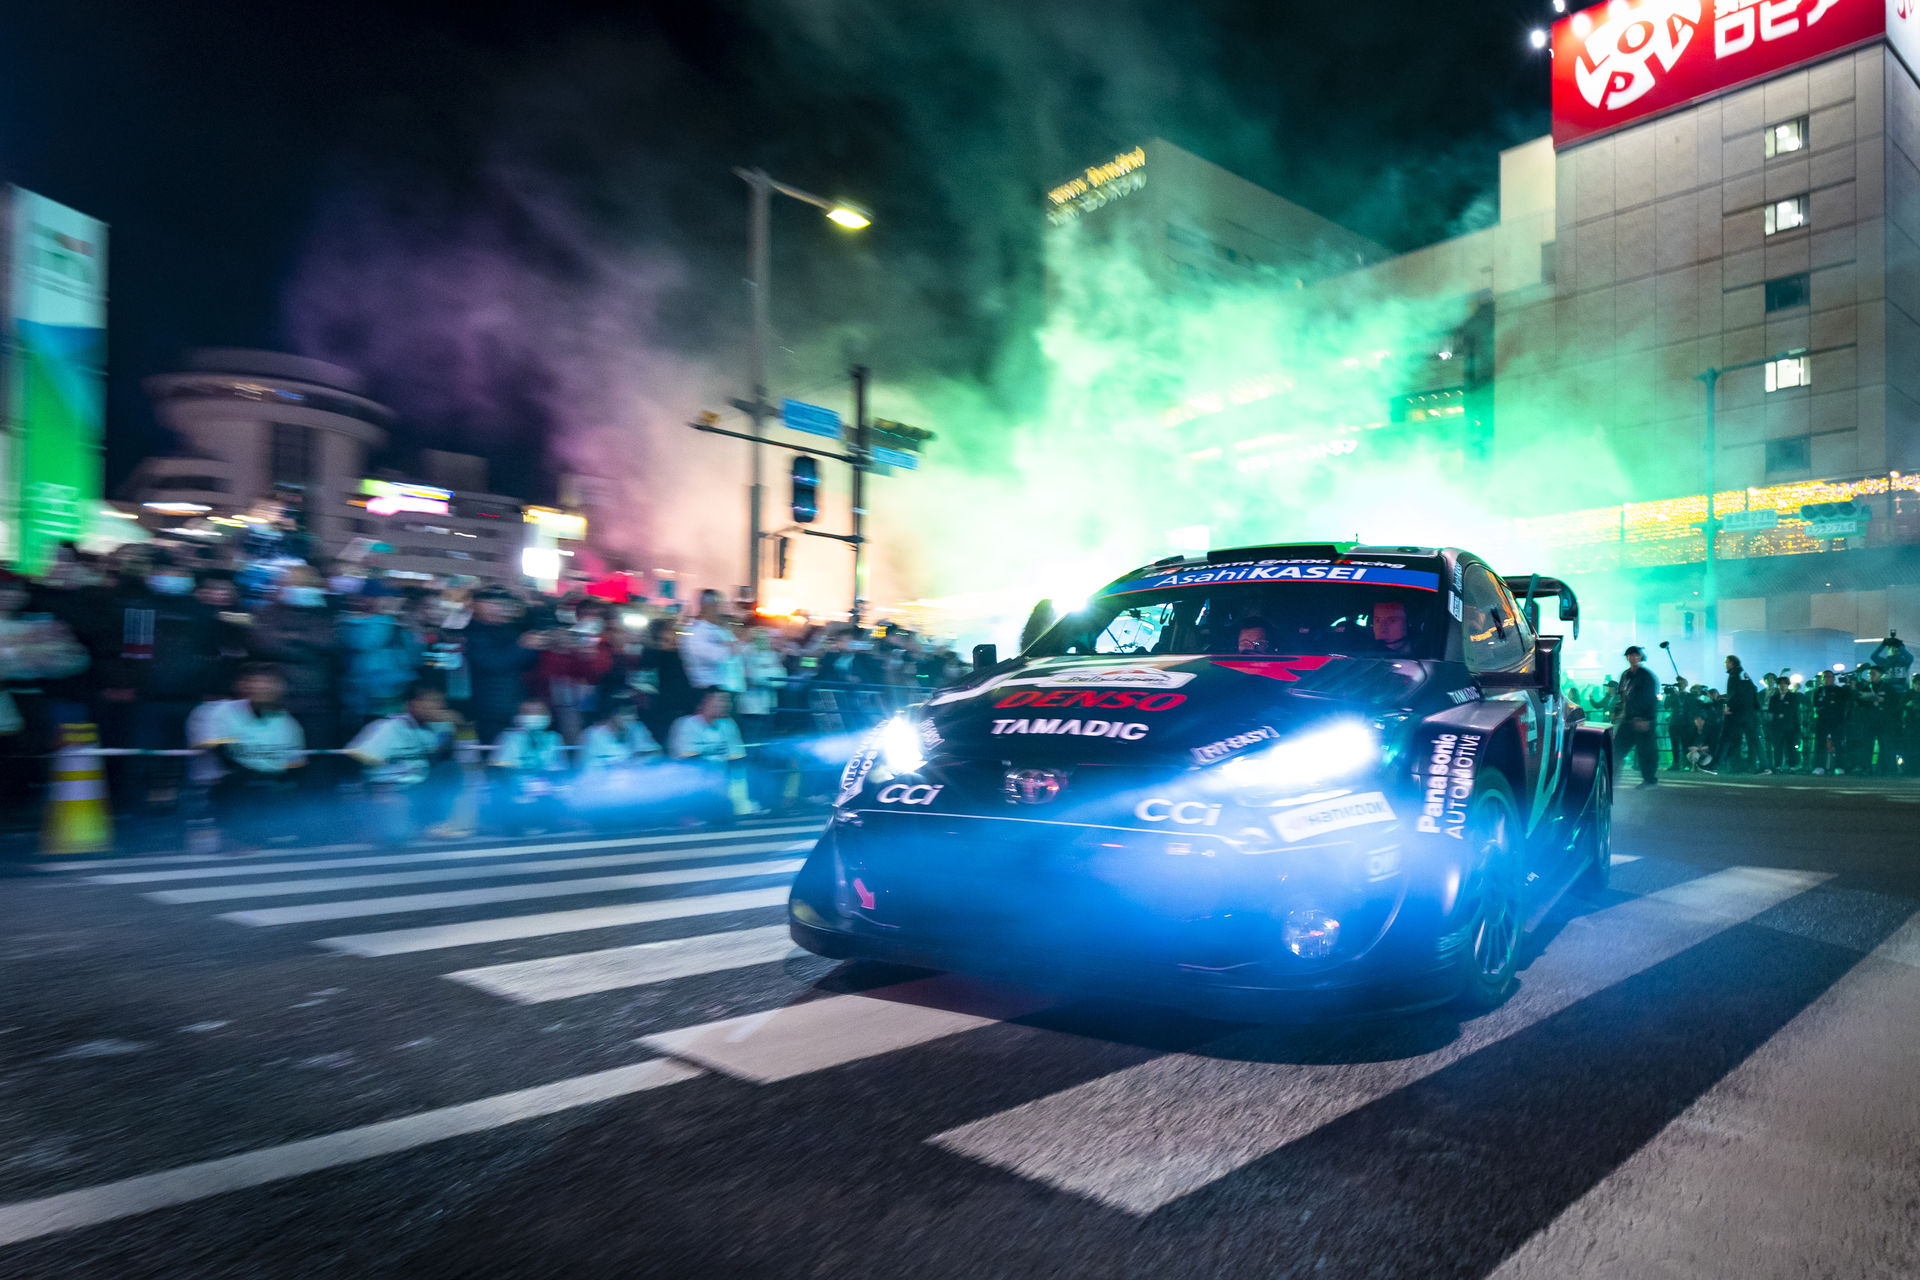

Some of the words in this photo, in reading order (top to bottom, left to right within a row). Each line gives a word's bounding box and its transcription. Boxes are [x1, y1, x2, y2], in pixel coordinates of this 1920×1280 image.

[991, 718, 1149, 740] TAMADIC
[992, 690, 1188, 711] DENSO
[1417, 733, 1458, 834] Panasonic
[1445, 734, 1482, 840] AUTOMOTIVE
